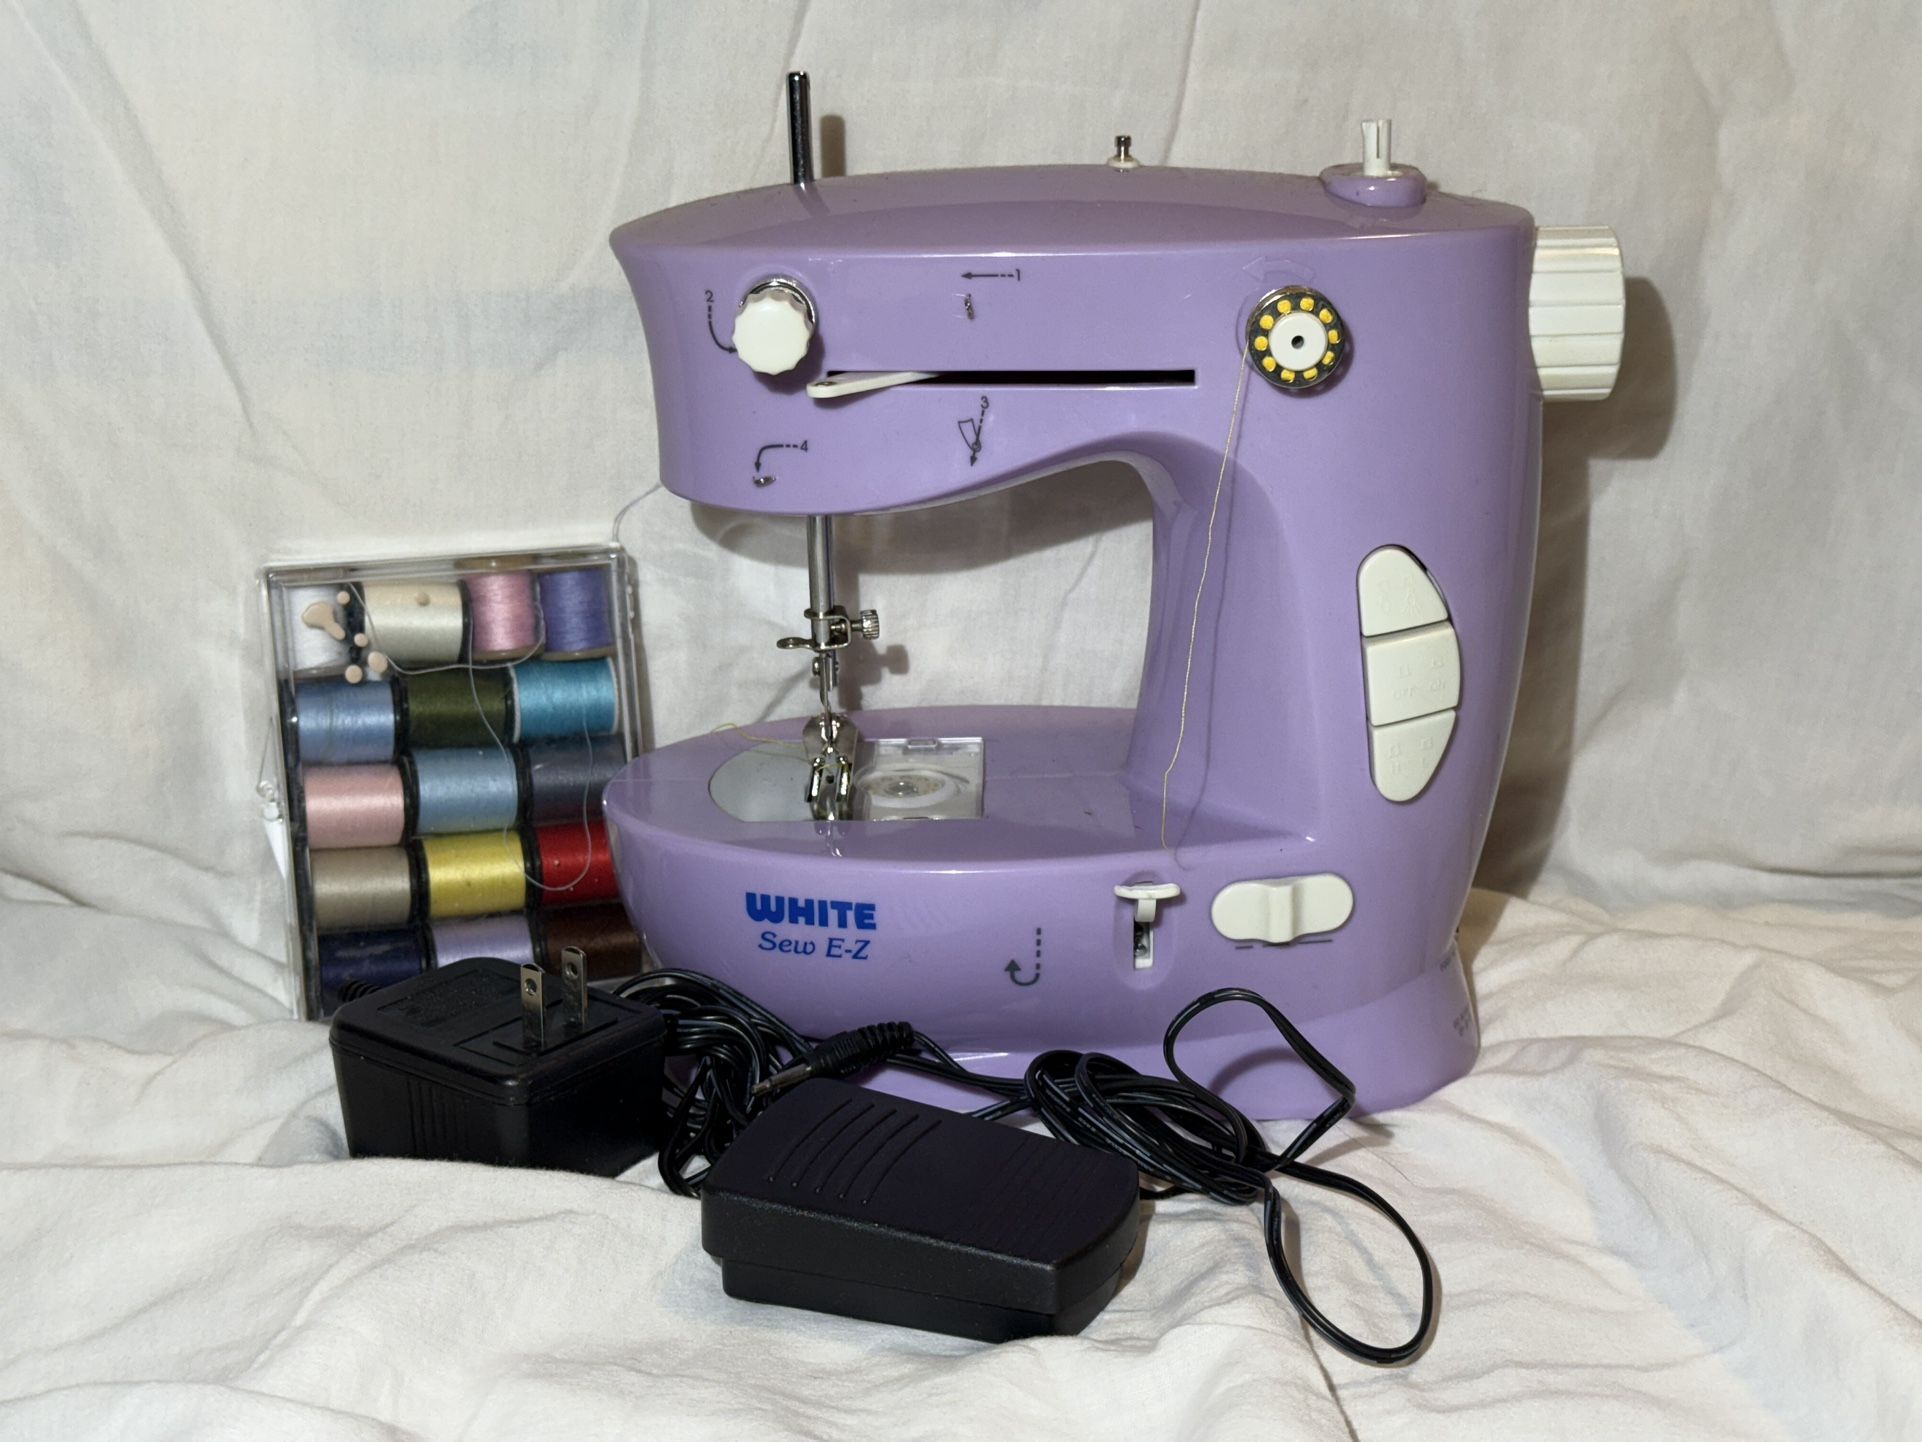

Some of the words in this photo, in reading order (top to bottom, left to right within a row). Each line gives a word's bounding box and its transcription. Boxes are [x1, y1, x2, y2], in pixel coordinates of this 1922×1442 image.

[704, 289, 715, 303] 2
[980, 395, 990, 410] 3
[800, 439, 809, 453] 4
[745, 892, 877, 930] WHITE
[757, 931, 816, 955] Sew
[825, 937, 871, 960] E-Z
